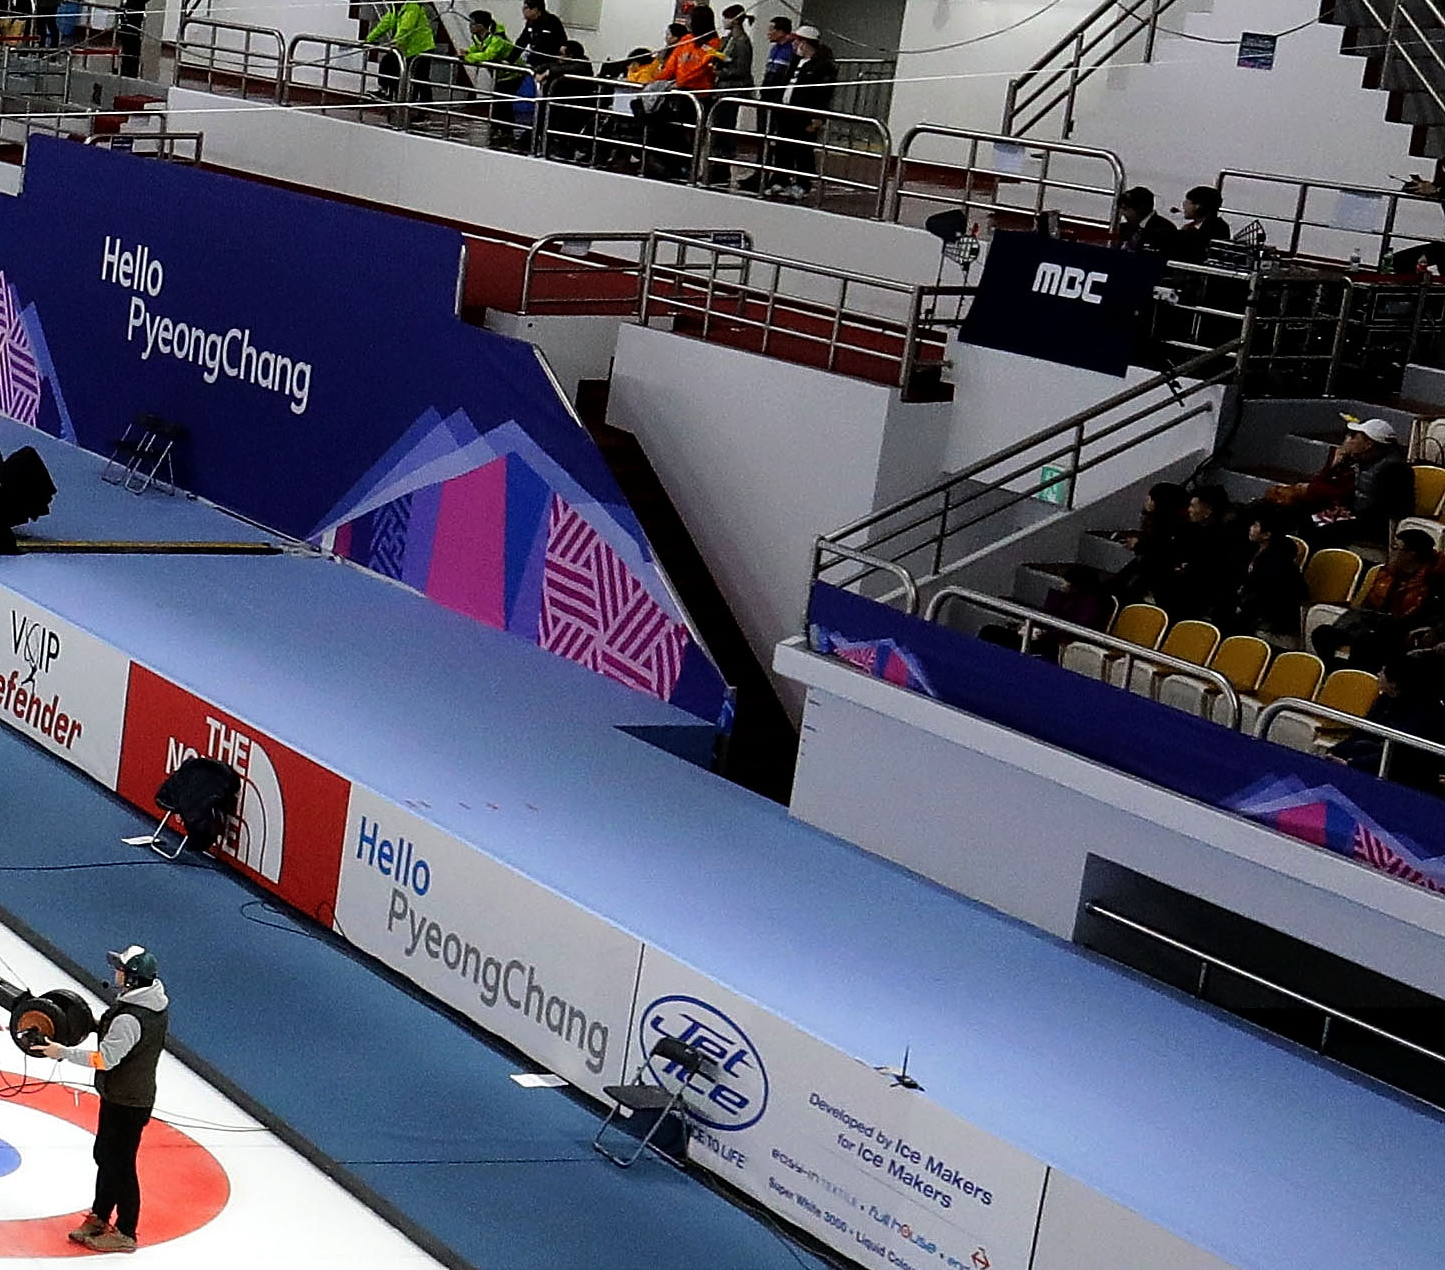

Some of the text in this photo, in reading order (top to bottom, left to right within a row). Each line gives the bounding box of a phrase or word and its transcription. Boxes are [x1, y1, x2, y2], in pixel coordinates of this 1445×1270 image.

[102, 235, 164, 297] Hello
[1031, 261, 1108, 305] MBC
[127, 294, 313, 416] PyeongChang
[205, 714, 250, 777] THE
[356, 815, 432, 896] Hello
[386, 887, 610, 1076] PyeongChang
[720, 1138, 747, 1170] LIFE
[808, 1091, 994, 1207] Developed by Ice Makers
[836, 1132, 954, 1210] for Ice Makers
[768, 1176, 795, 1200] Super
[795, 1188, 822, 1213] White
[822, 1207, 849, 1234] 3000
[854, 1228, 885, 1256] Liquid
